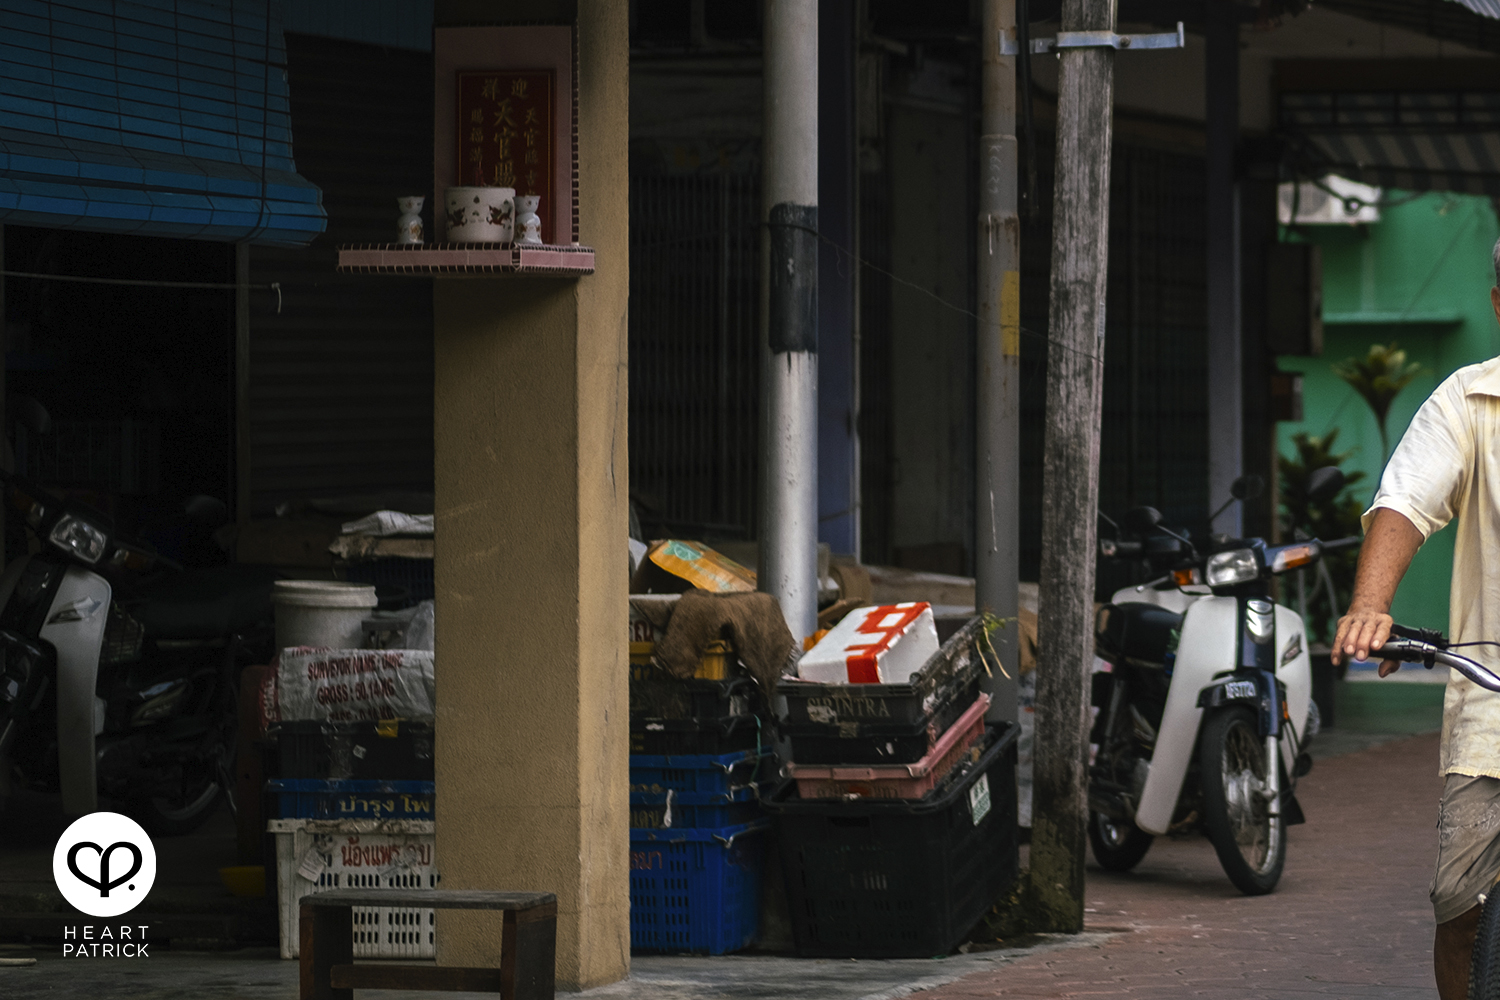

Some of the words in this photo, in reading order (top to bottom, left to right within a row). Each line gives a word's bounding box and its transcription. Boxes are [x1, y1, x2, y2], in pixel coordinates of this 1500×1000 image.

[308, 656, 351, 682] SURVEYOR
[353, 654, 376, 674] NAME
[317, 683, 349, 706] GROSS
